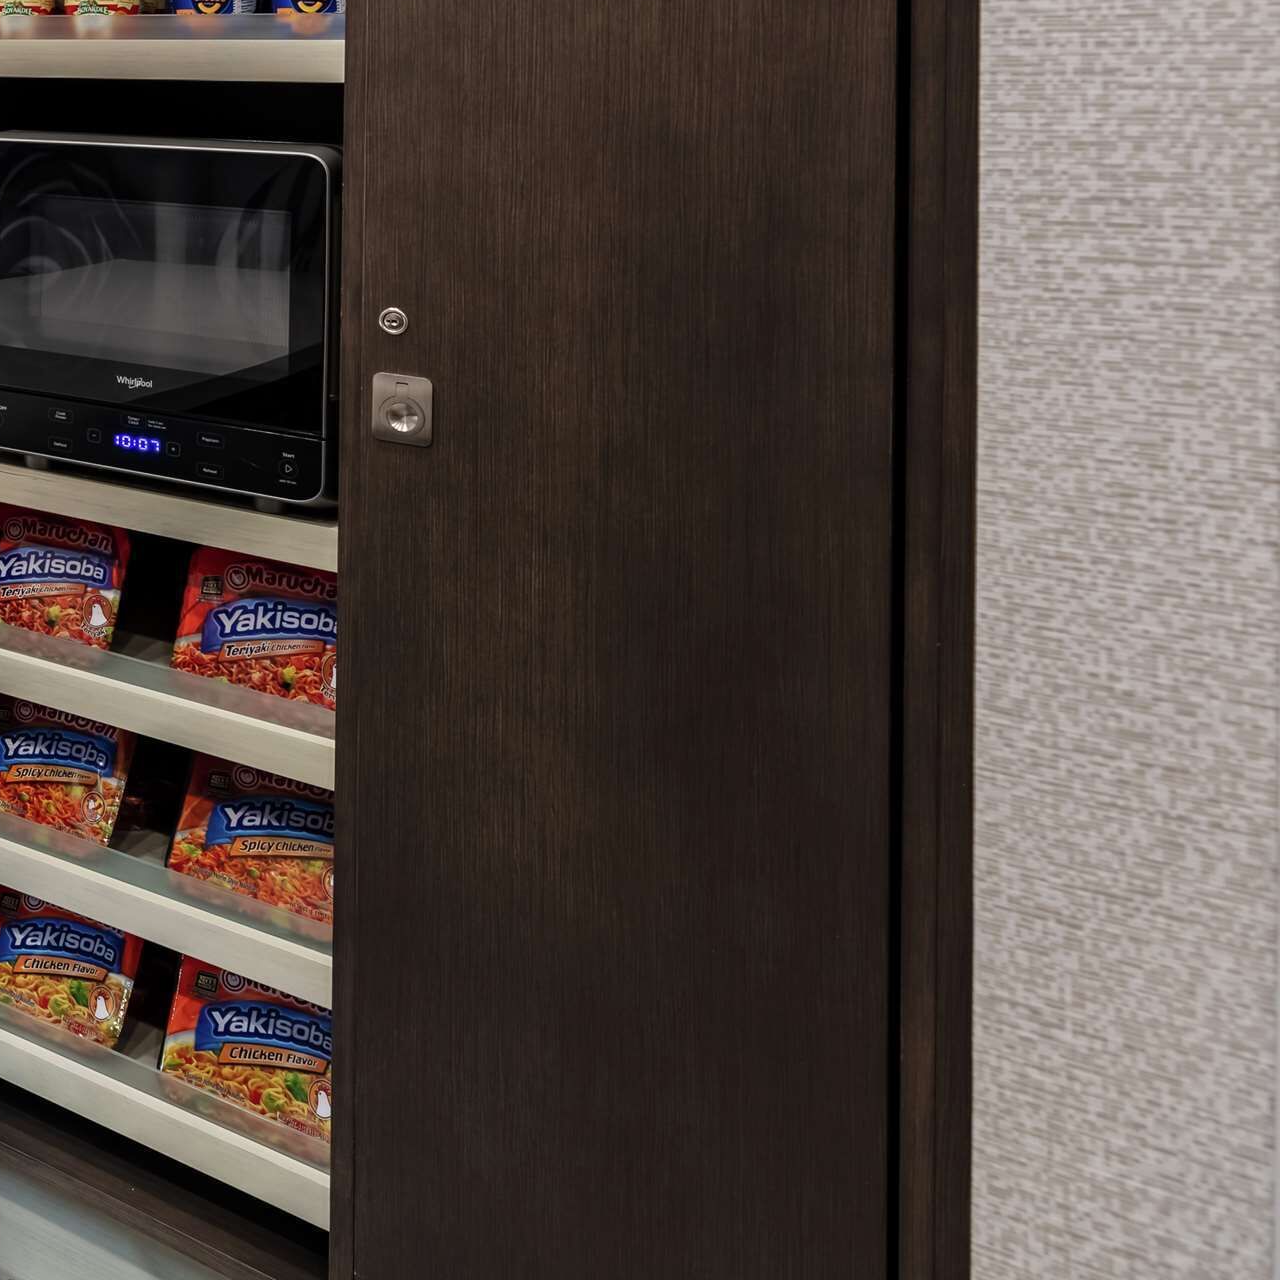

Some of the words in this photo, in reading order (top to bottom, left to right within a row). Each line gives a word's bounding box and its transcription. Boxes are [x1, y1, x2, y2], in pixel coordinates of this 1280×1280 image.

[116, 375, 153, 390] Whirlpool
[114, 433, 161, 453] 10:07
[22, 518, 113, 554] Maruchan
[0, 586, 39, 598] Teriyaki
[247, 564, 337, 600] Marucha
[226, 644, 269, 657] Teriyaki
[5, 735, 107, 766] Yakisoba
[15, 767, 42, 778] Spicy
[224, 803, 335, 833] Yakisob
[240, 839, 274, 852] Spicy
[275, 840, 314, 852] Chicken
[11, 925, 115, 963] Yakisoba
[23, 957, 70, 971] Chicken
[72, 963, 98, 976] Flavor
[229, 1046, 283, 1062] Chicken
[286, 1053, 318, 1067] Flavor
